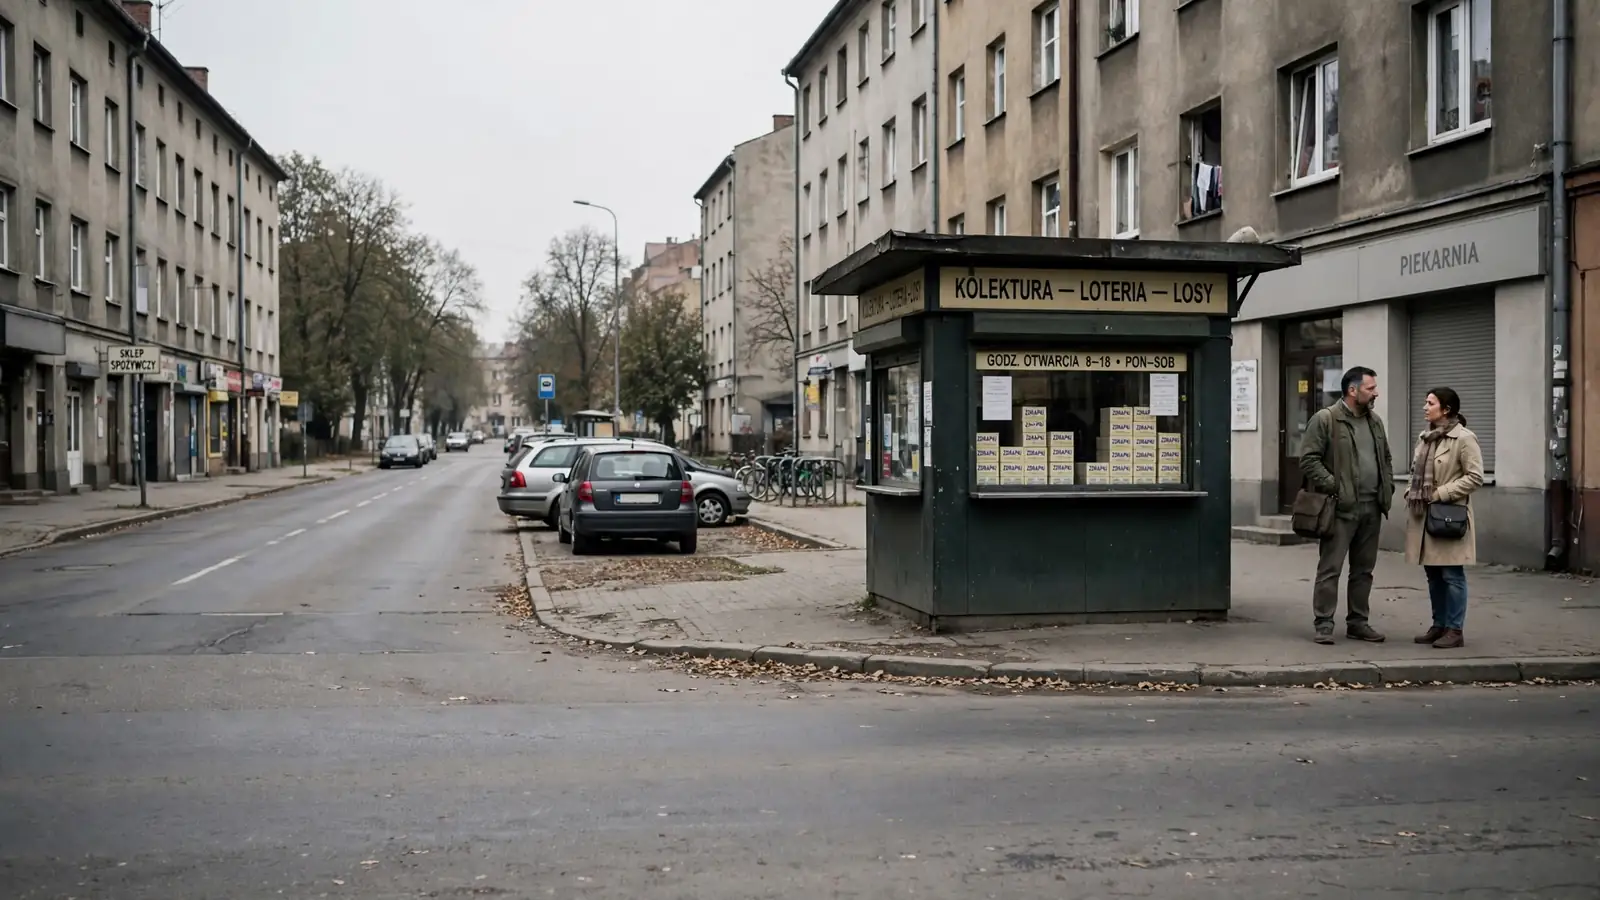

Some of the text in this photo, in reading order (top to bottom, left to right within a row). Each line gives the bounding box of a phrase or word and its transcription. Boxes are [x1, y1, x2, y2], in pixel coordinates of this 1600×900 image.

[1400, 242, 1479, 276] PIEKARNIA
[955, 277, 1053, 300] KOLEKTURA
[1080, 280, 1147, 302] LOTERIA
[1173, 282, 1213, 303] LOSY
[120, 348, 144, 358] SKLEP
[987, 354, 1019, 366] GODZ.
[1023, 354, 1079, 367] OTWARCIA
